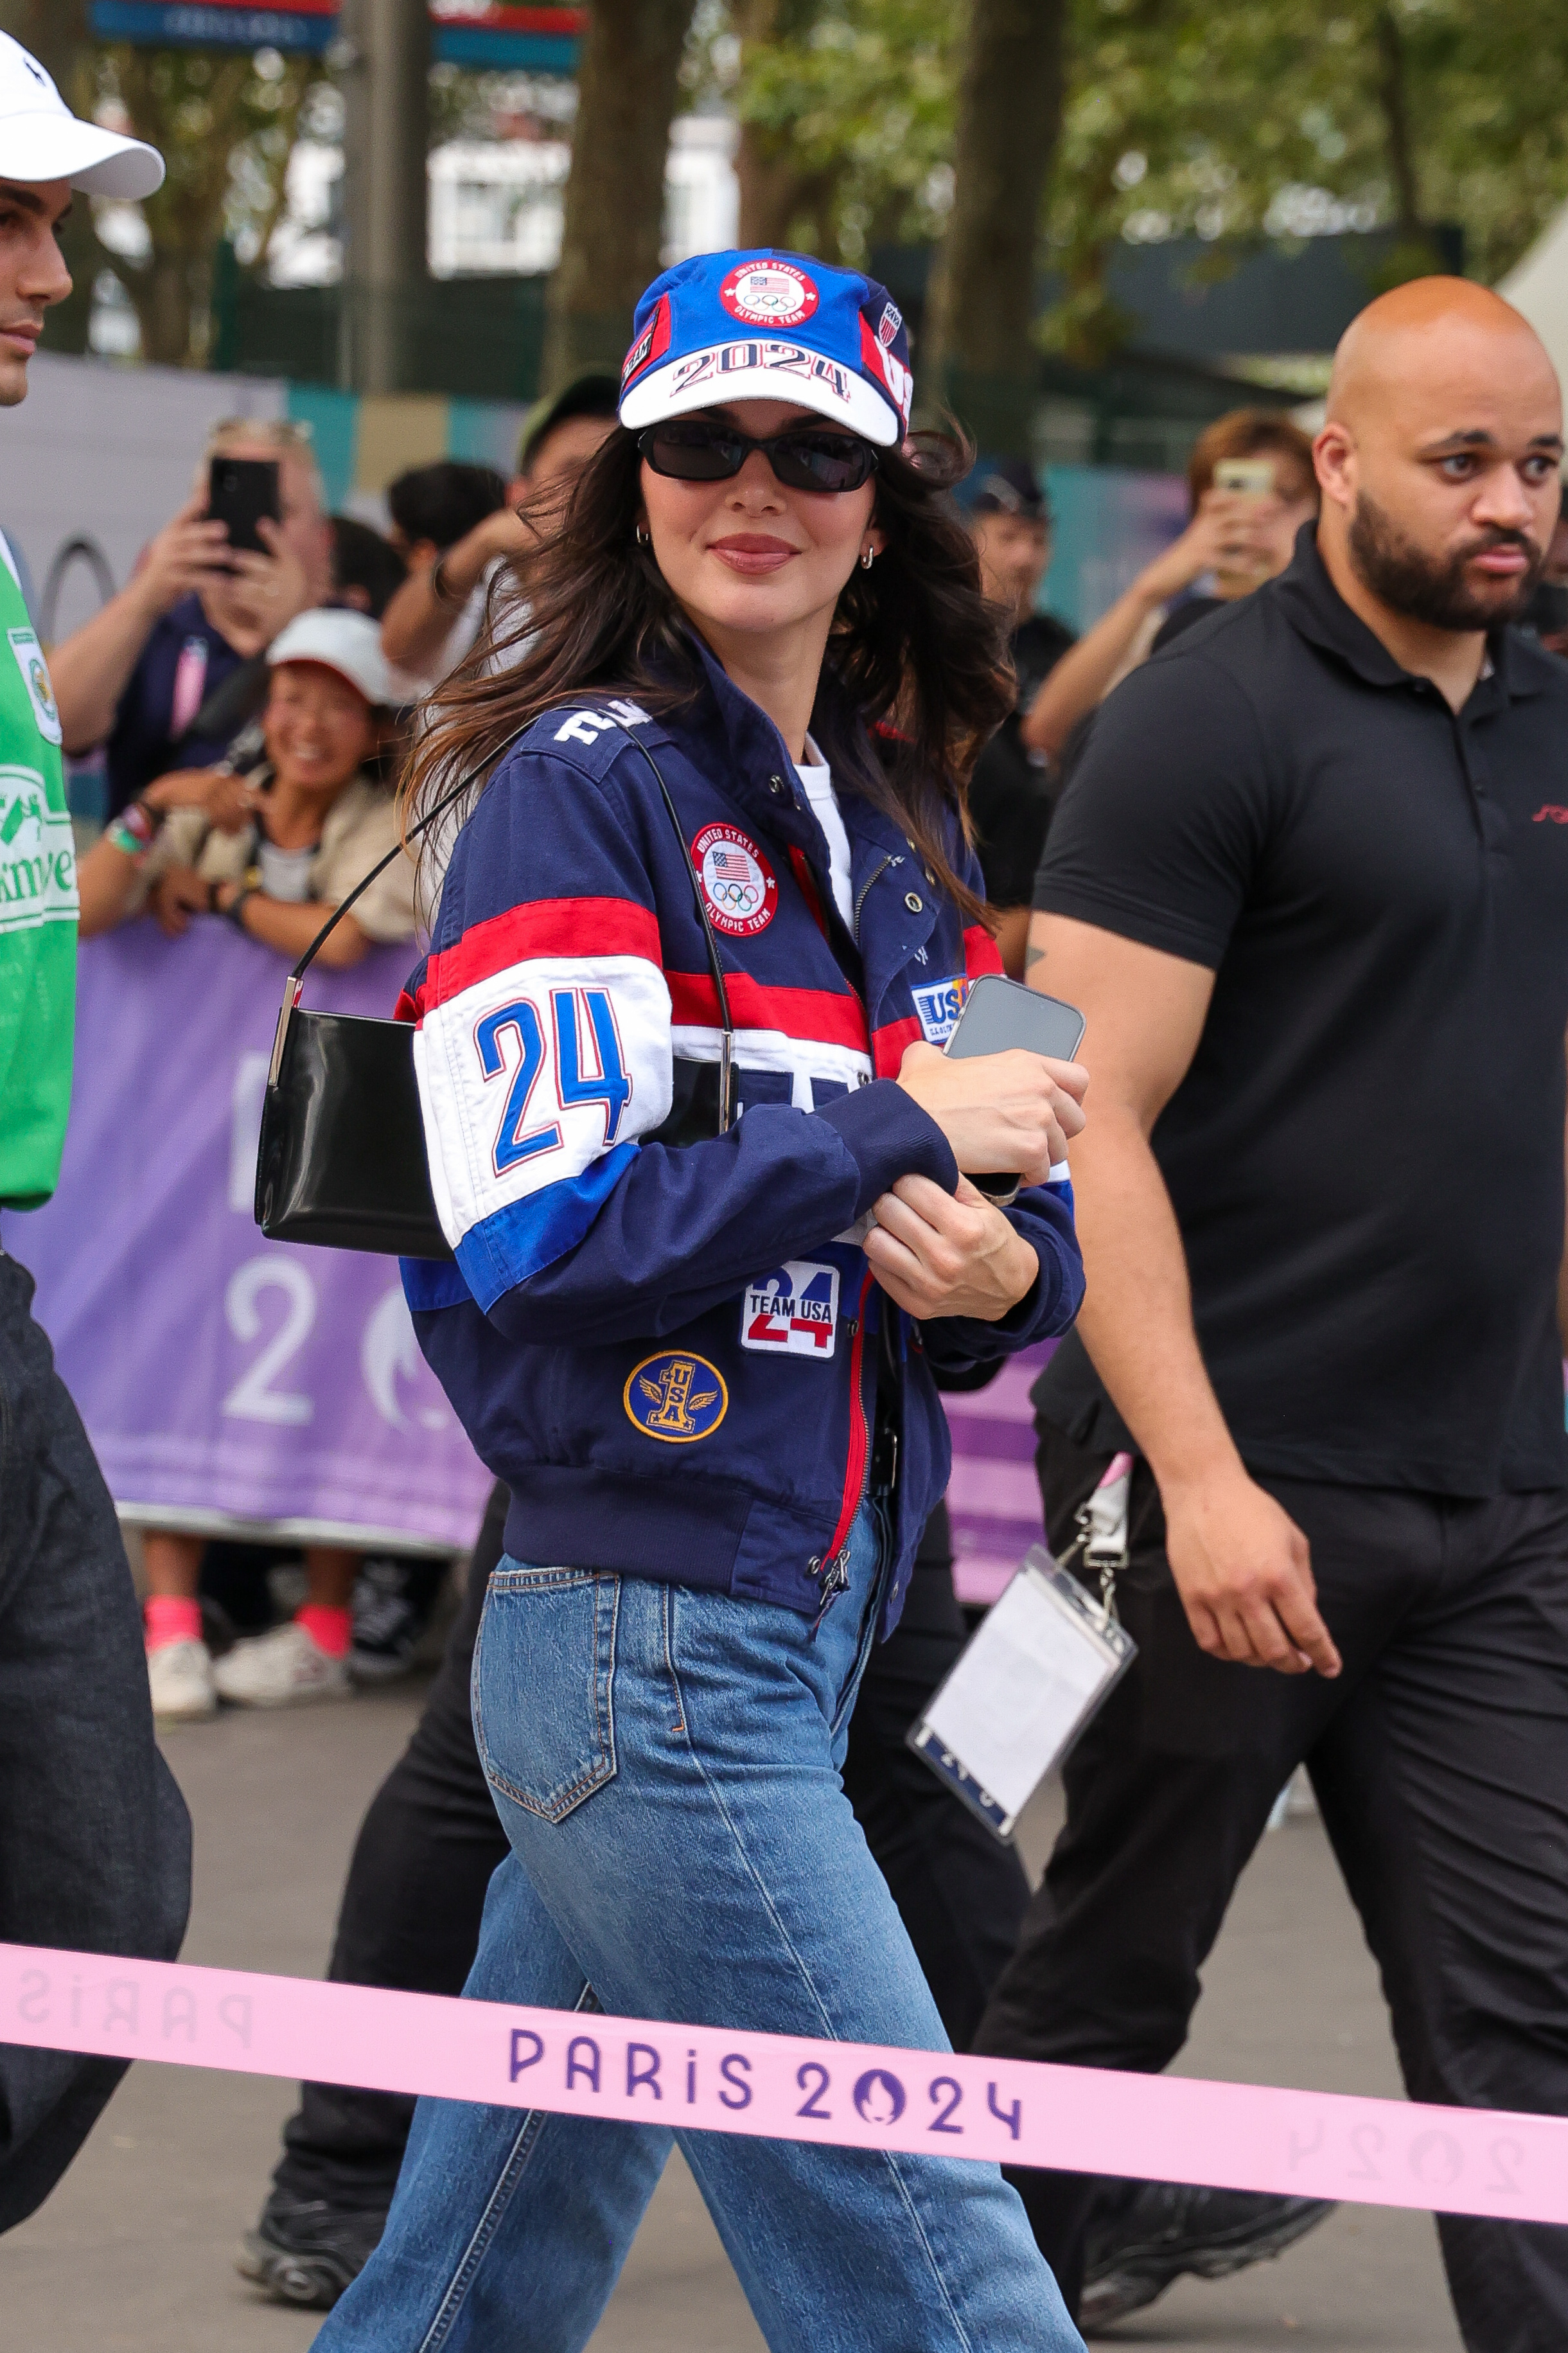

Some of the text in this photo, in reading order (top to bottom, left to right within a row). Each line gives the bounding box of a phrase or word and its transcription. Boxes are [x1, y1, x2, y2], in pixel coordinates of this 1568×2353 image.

[734, 262, 806, 281] UNITED STATES
[734, 305, 806, 324] OLYMPIC TEAM
[669, 342, 850, 403] 2024
[696, 828, 759, 858] UNITED STATES
[705, 902, 771, 932] OLYMPIC TEAM
[473, 988, 633, 1178] 24
[750, 1294, 832, 1324] TEAM USA
[664, 1368, 691, 1422] USA
[795, 2061, 1022, 2140] 2024
